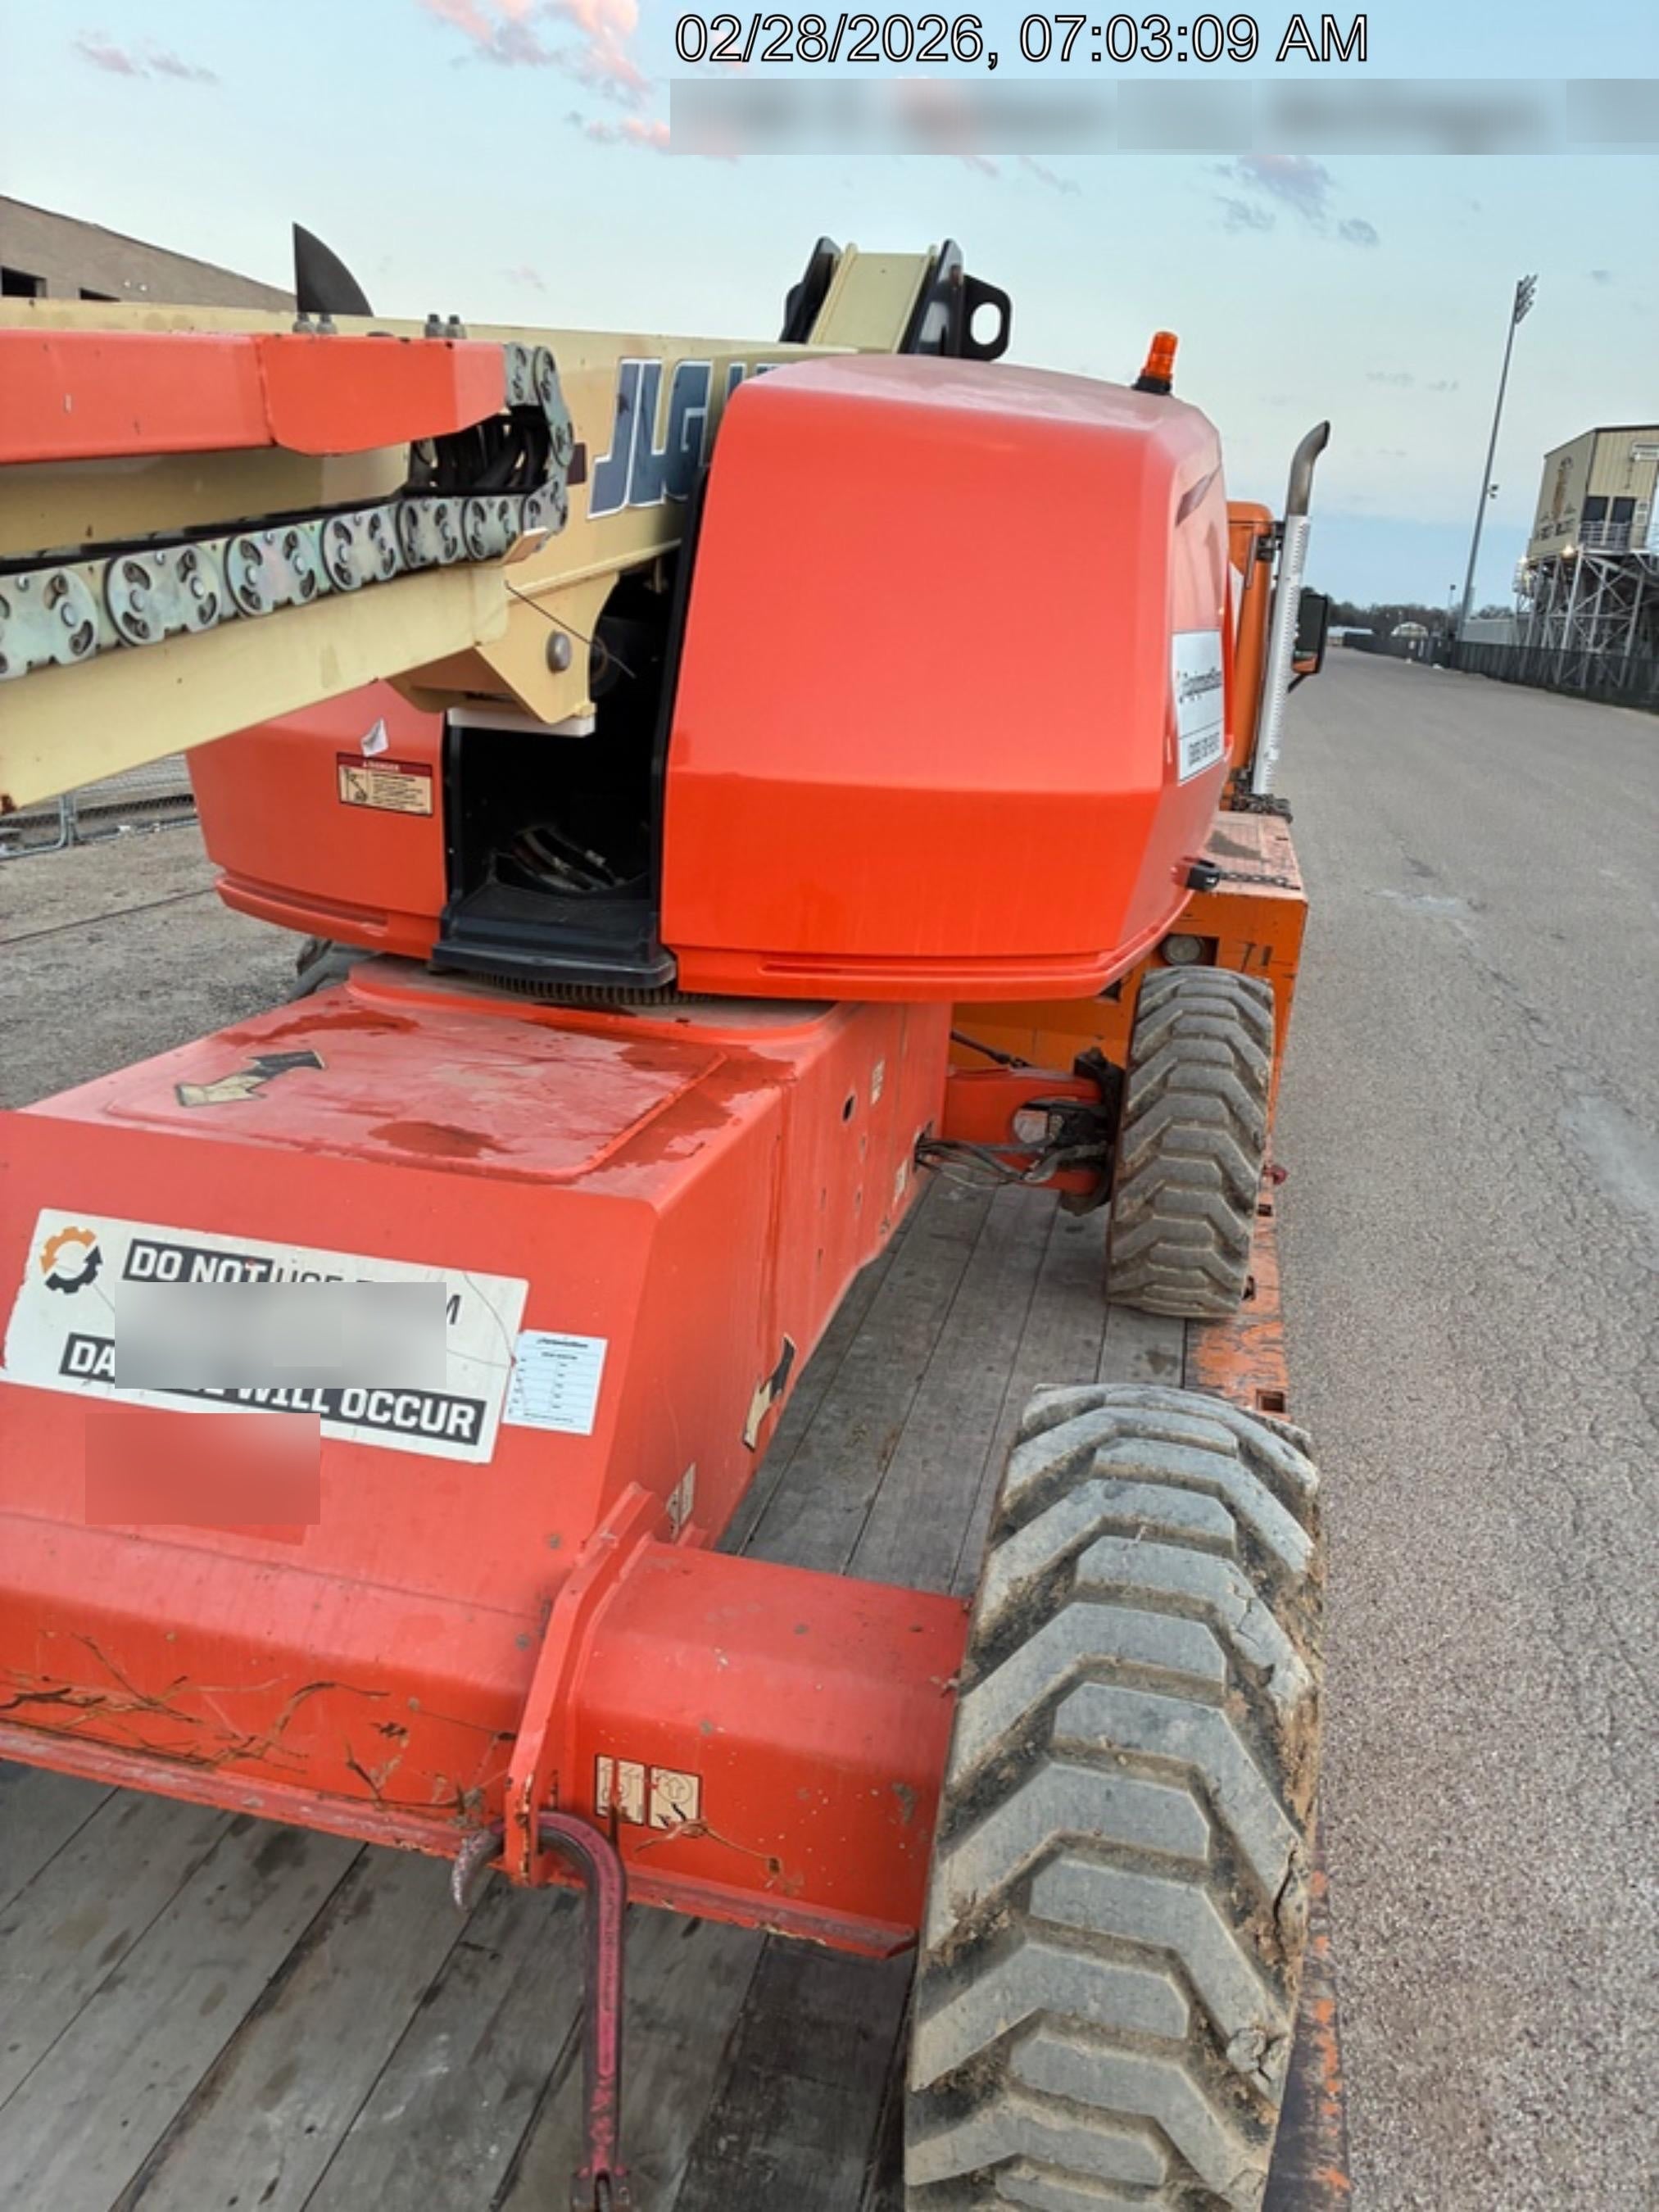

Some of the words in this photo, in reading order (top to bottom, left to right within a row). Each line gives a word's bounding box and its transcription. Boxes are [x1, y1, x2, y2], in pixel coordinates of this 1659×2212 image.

[129, 1245, 183, 1281] DO
[188, 1254, 269, 1283] NOT
[340, 1388, 476, 1439] OCCUR
